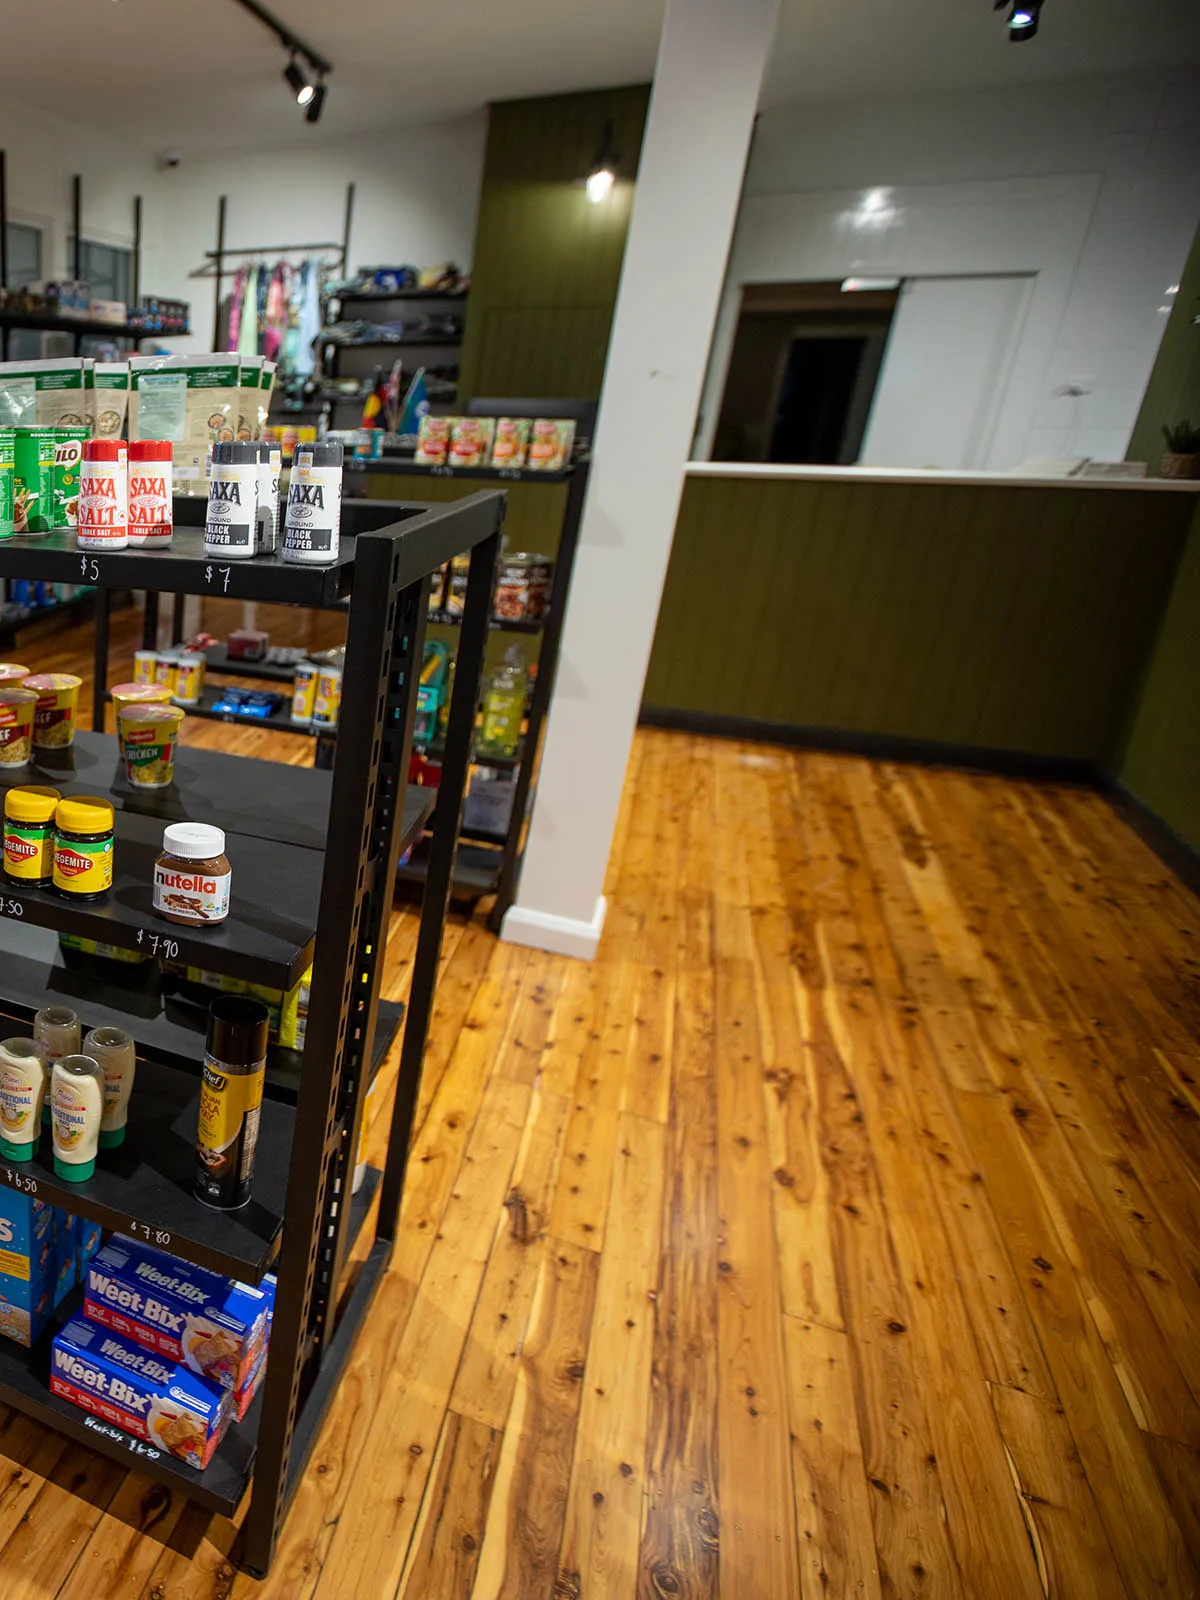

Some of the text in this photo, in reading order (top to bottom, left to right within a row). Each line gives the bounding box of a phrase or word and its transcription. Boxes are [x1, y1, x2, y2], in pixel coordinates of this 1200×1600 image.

[55, 449, 78, 462] ILO
[81, 477, 116, 500] SAXA
[129, 477, 167, 499] SAXA
[80, 504, 117, 526] SALT
[128, 503, 167, 524] SALT
[205, 534, 230, 544] PEPPER
[207, 524, 229, 535] BLACK
[287, 529, 311, 539] BLACK
[285, 539, 313, 550] PEPPER
[80, 555, 99, 580] $5
[205, 565, 231, 593] $7
[156, 871, 217, 894] nutella
[6, 1169, 38, 1193] $6.50
[135, 1262, 211, 1305] Weet-Bix
[89, 1270, 185, 1333] Weet-Bix
[100, 1338, 176, 1385] Weet-Bix
[54, 1348, 149, 1414] Weet-Bix
